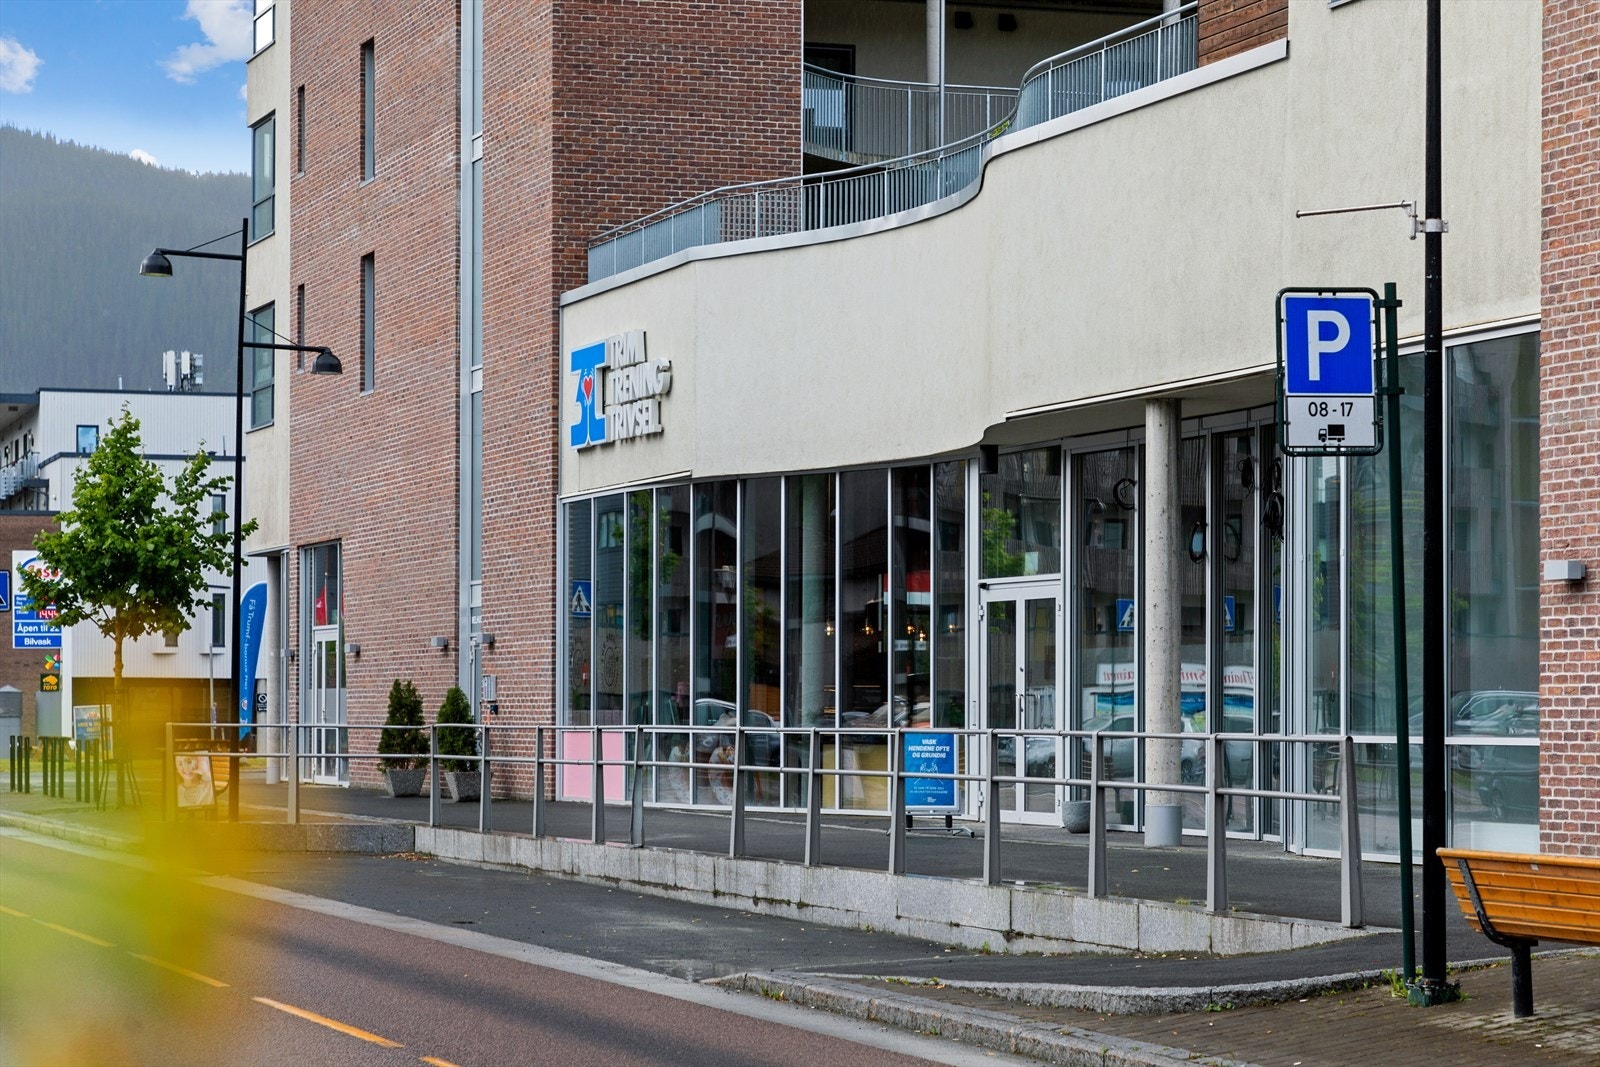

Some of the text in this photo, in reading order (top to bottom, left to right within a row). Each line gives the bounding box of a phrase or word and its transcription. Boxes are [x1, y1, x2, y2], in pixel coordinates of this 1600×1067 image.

[608, 330, 646, 370] TRIM
[1307, 310, 1351, 381] P
[608, 357, 671, 405] TRENING
[608, 399, 662, 441] TRIVSEL
[17, 622, 39, 634] Åpen
[24, 637, 52, 646] Bilvask
